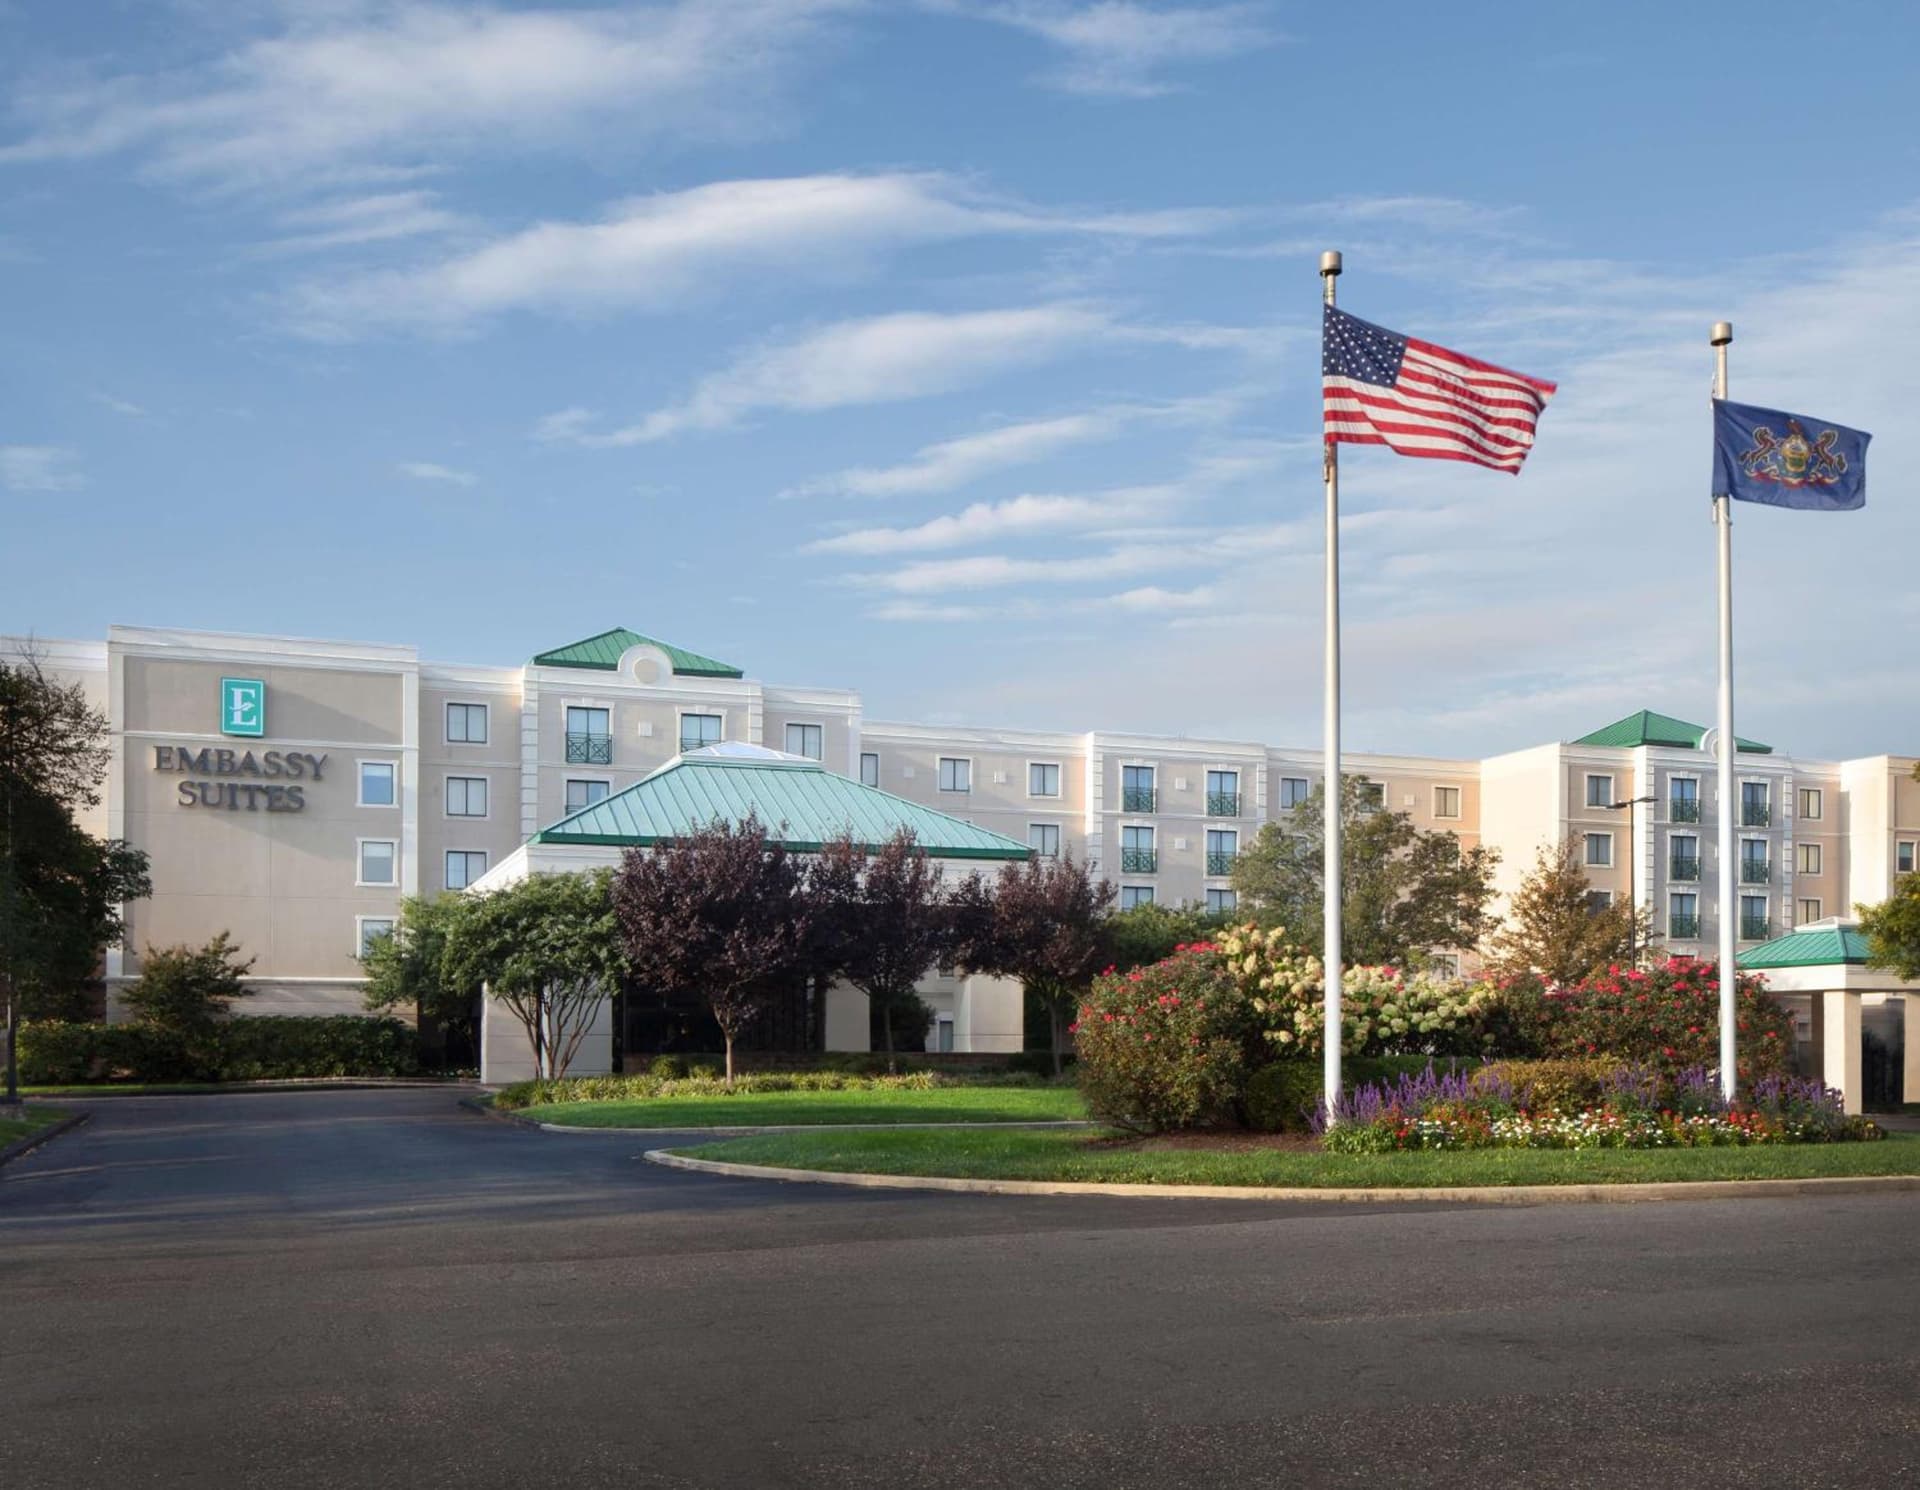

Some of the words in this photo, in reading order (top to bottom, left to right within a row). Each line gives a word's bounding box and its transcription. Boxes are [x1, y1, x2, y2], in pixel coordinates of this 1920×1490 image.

[230, 687, 257, 726] E
[153, 745, 328, 780] EMBASSY
[178, 780, 305, 812] SUITES
